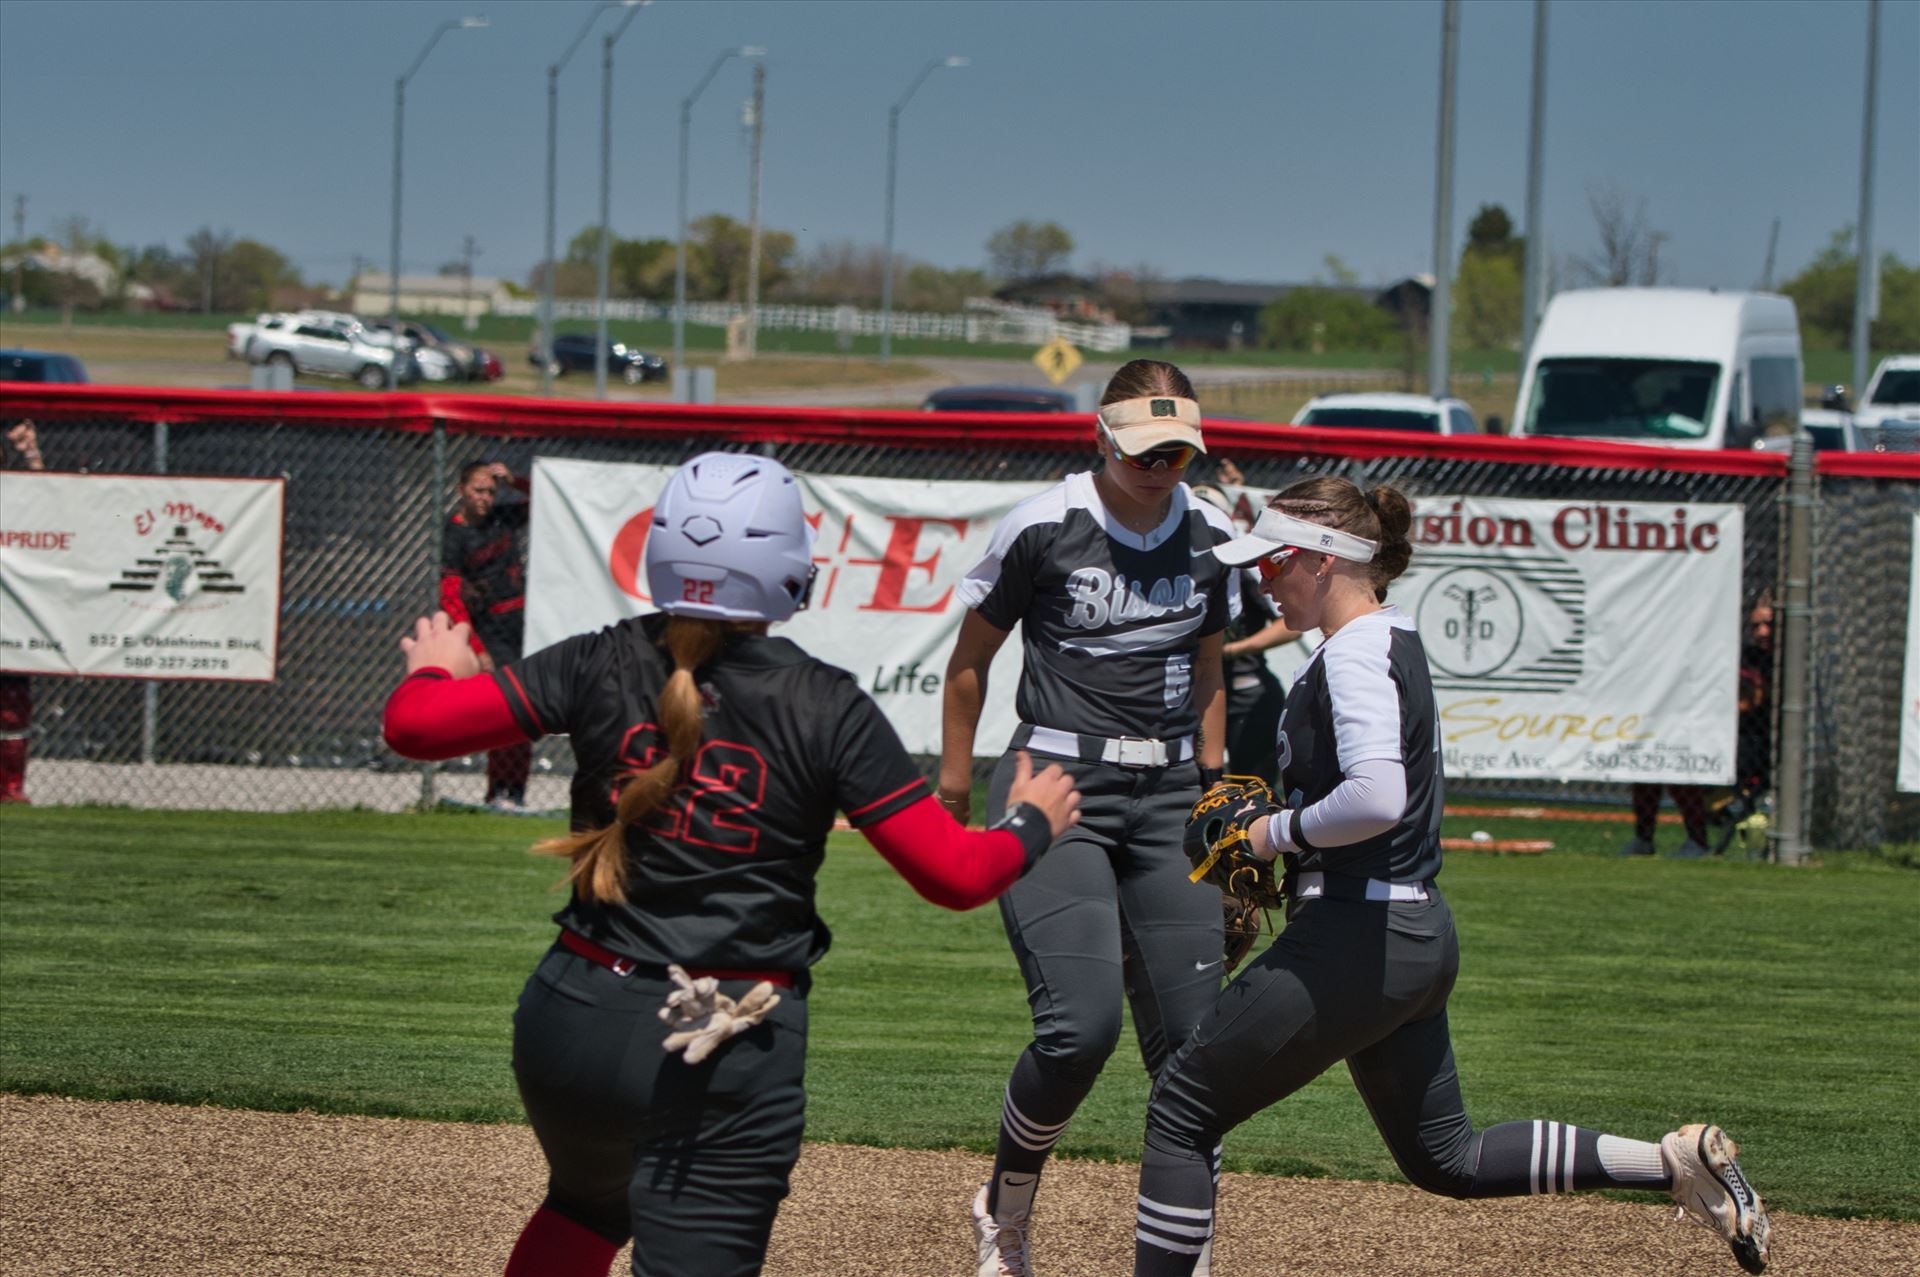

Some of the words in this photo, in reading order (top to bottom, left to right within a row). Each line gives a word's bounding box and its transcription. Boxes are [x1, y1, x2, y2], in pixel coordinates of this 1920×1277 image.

[1407, 500, 1535, 547] ision
[1552, 505, 1720, 553] Clinic
[683, 577, 715, 604] 22
[1064, 567, 1207, 629] Bison
[143, 634, 221, 649] Oklahoma
[1479, 620, 1494, 640] D
[872, 663, 940, 695] Life
